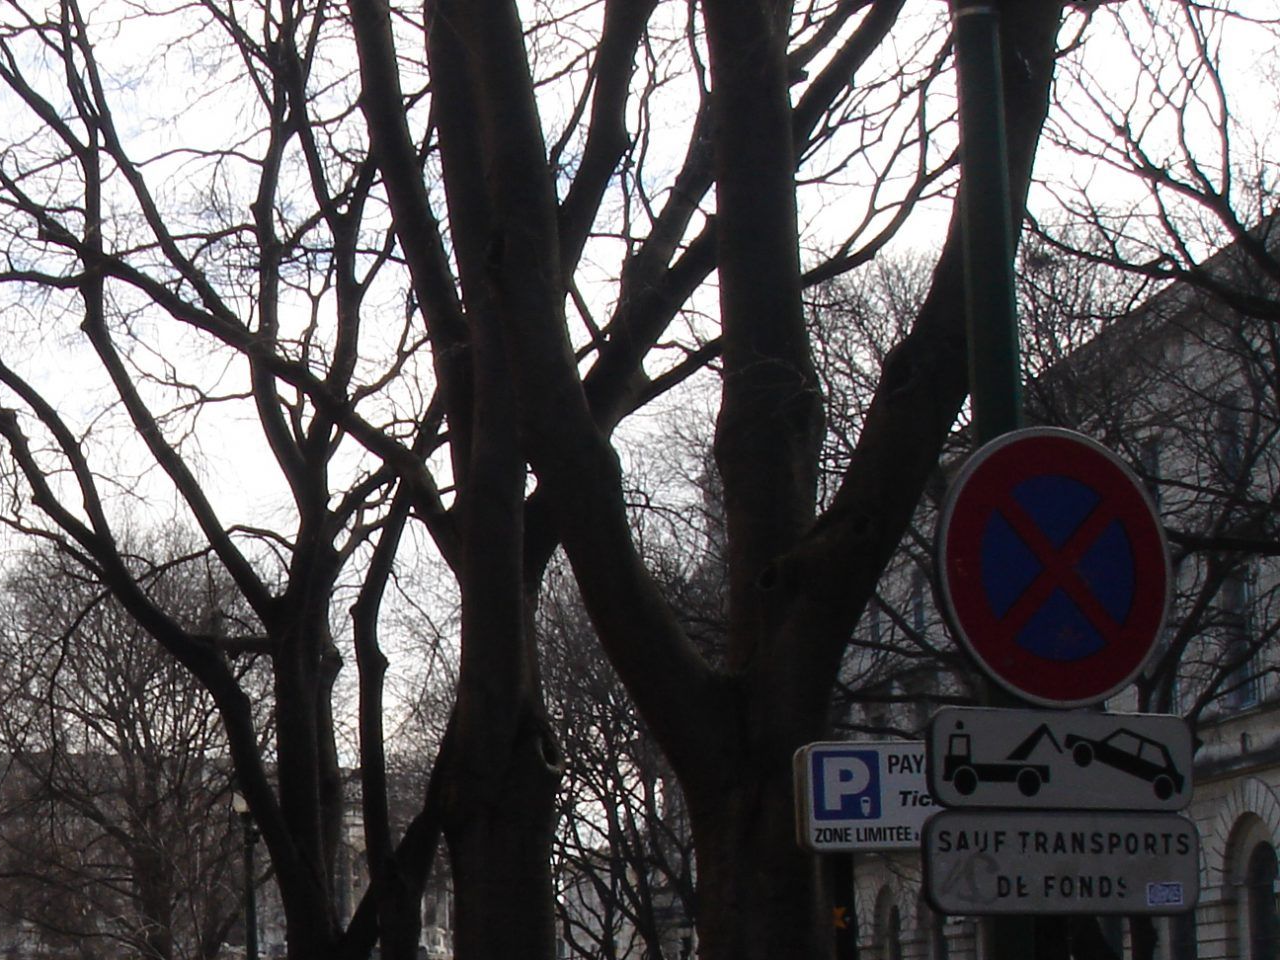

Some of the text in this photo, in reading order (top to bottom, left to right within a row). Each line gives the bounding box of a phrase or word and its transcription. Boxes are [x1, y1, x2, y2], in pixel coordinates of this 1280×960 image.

[888, 754, 928, 774] PAY
[899, 790, 938, 807] Tic
[815, 828, 852, 843] ZONE
[856, 826, 911, 842] LIMITÉE
[938, 831, 1190, 855] SAUF TRANSPORTS
[996, 876, 1027, 898] DE
